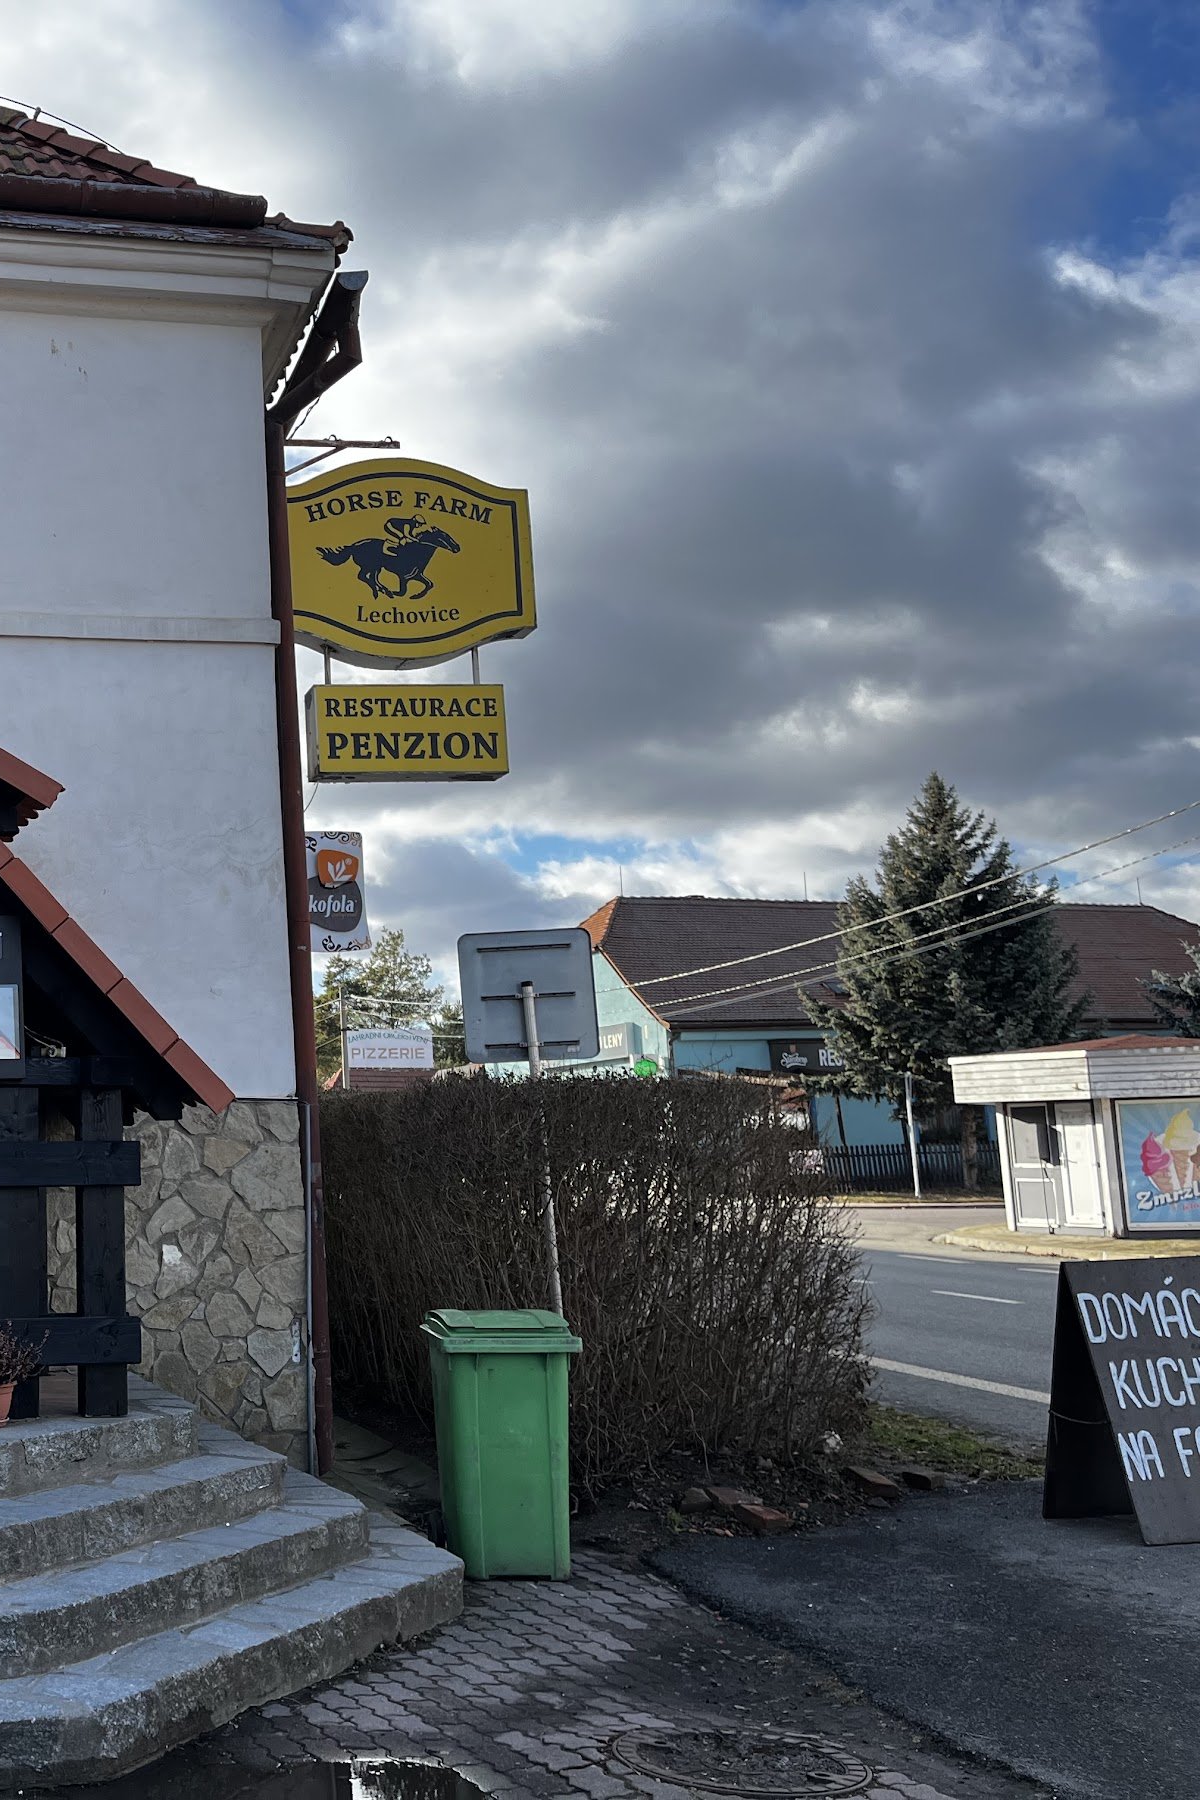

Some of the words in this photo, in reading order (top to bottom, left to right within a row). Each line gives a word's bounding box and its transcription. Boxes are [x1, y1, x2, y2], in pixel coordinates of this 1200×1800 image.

[304, 490, 403, 523] HORSE
[414, 491, 493, 525] FARM
[356, 605, 460, 624] Lechovice
[325, 698, 498, 717] RESTAURACE
[326, 732, 499, 760] PENZION
[308, 894, 355, 917] kofola
[351, 1047, 425, 1060] PIZZERIE
[1117, 1429, 1165, 1482] NA
[1173, 1427, 1200, 1479] F
